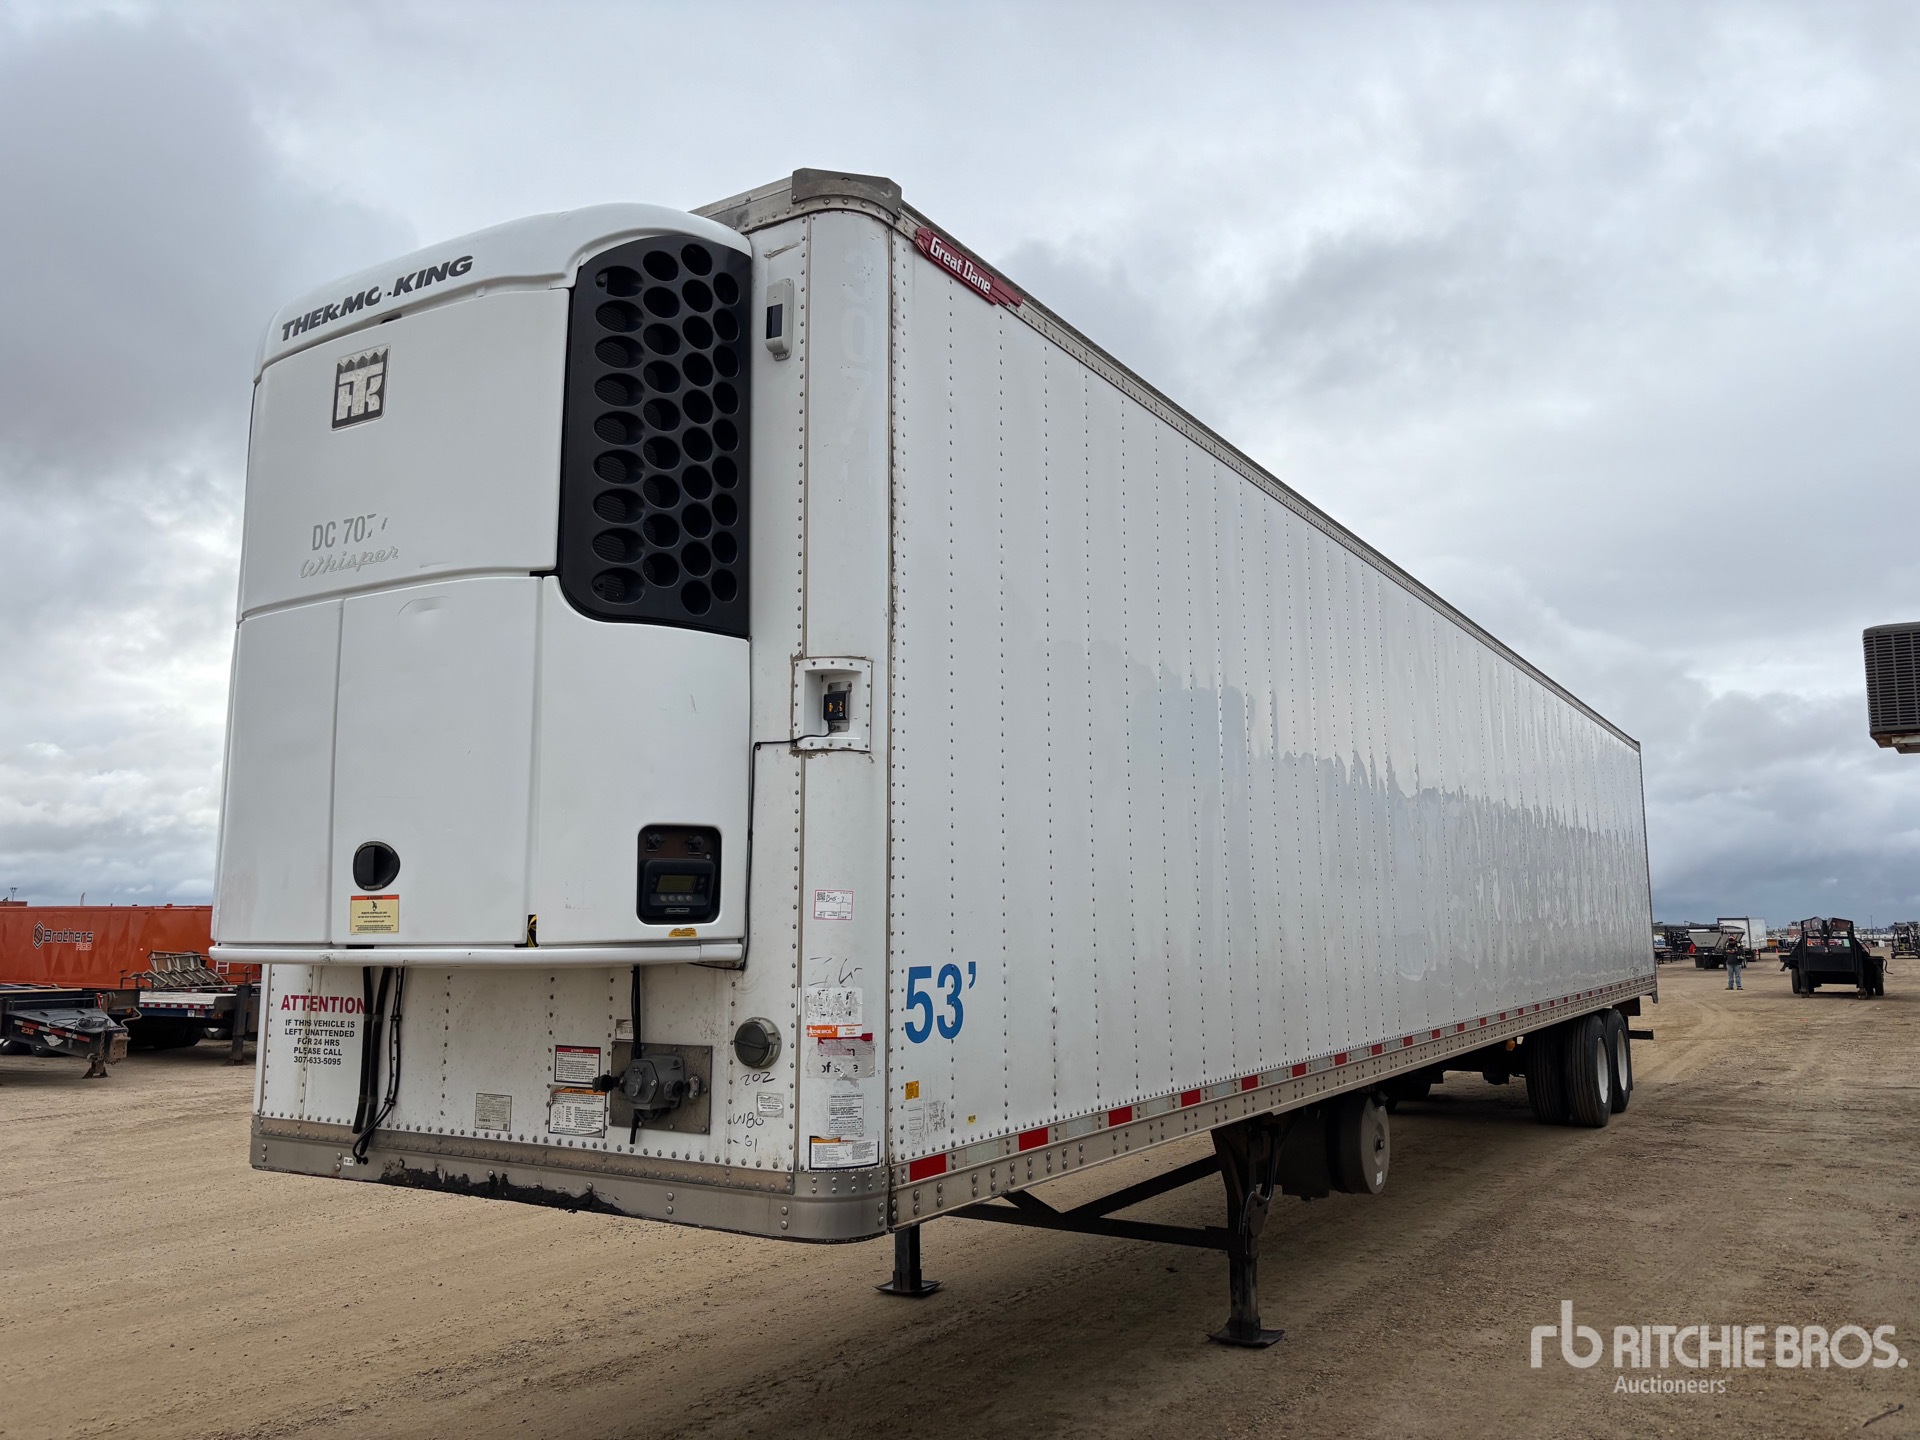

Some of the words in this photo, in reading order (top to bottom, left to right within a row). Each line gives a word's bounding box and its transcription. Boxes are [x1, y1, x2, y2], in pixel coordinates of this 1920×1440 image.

[930, 236, 963, 274] Great
[962, 260, 991, 295] Dane
[392, 255, 474, 298] KING
[312, 521, 336, 551] DC
[43, 928, 93, 943] Brothers
[281, 994, 366, 1015] ATTENTION
[285, 1018, 292, 1026] IF
[294, 1019, 312, 1027] THIS
[313, 1020, 345, 1028] VEHICLE
[347, 1021, 355, 1029] IS
[284, 1028, 303, 1036] LEFT
[305, 1029, 355, 1038] UNATTENDED
[297, 1037, 312, 1045] FOR
[314, 1038, 322, 1046] 24
[324, 1039, 340, 1047] HRS
[293, 1046, 321, 1055] PLEASE
[323, 1048, 343, 1056] CALL
[293, 1056, 342, 1066] 307-633-5095
